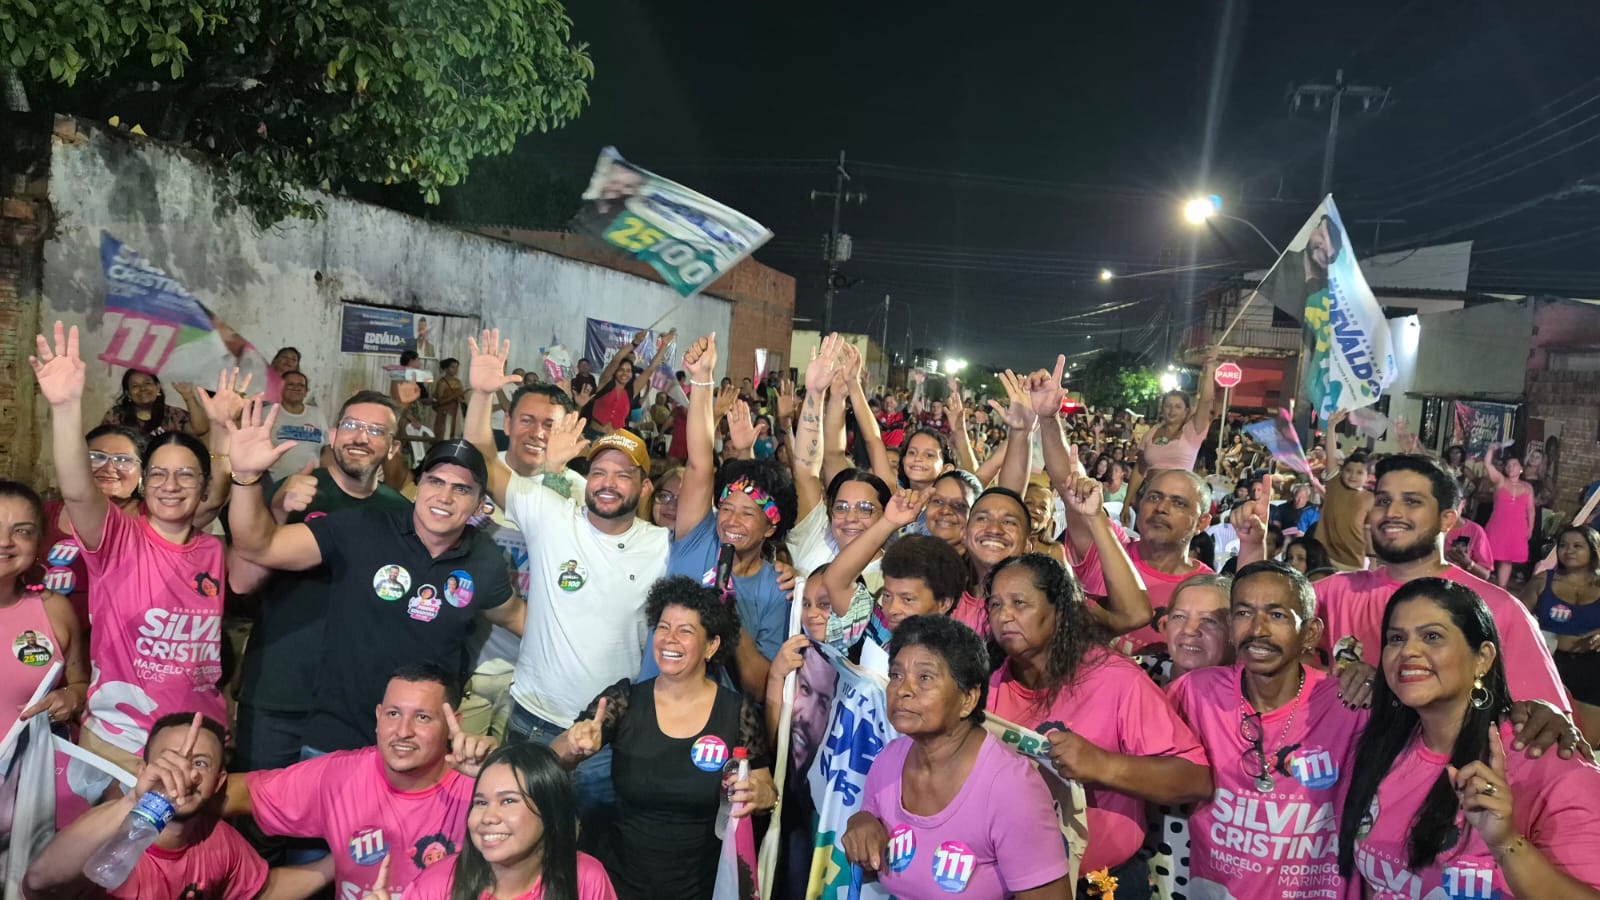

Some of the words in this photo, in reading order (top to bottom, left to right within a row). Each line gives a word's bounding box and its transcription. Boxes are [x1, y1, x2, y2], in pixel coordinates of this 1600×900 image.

[99, 311, 178, 368] 111
[1217, 370, 1241, 379] PARE
[49, 544, 79, 561] 111
[23, 654, 50, 663] 25100
[135, 636, 222, 663] CRISTIN
[136, 669, 167, 683] UCAS
[694, 743, 725, 764] 111
[1295, 750, 1334, 782] 111
[351, 828, 384, 860] 111
[887, 829, 913, 865] 111
[1210, 821, 1341, 861] CRISTINA
[935, 849, 974, 882] 111
[1210, 847, 1263, 873] MARCELO
[1210, 860, 1244, 880] LUCAS
[1277, 875, 1342, 888] MARINHO
[1281, 889, 1338, 899] SUPLENTES
[1446, 866, 1493, 899] 111
